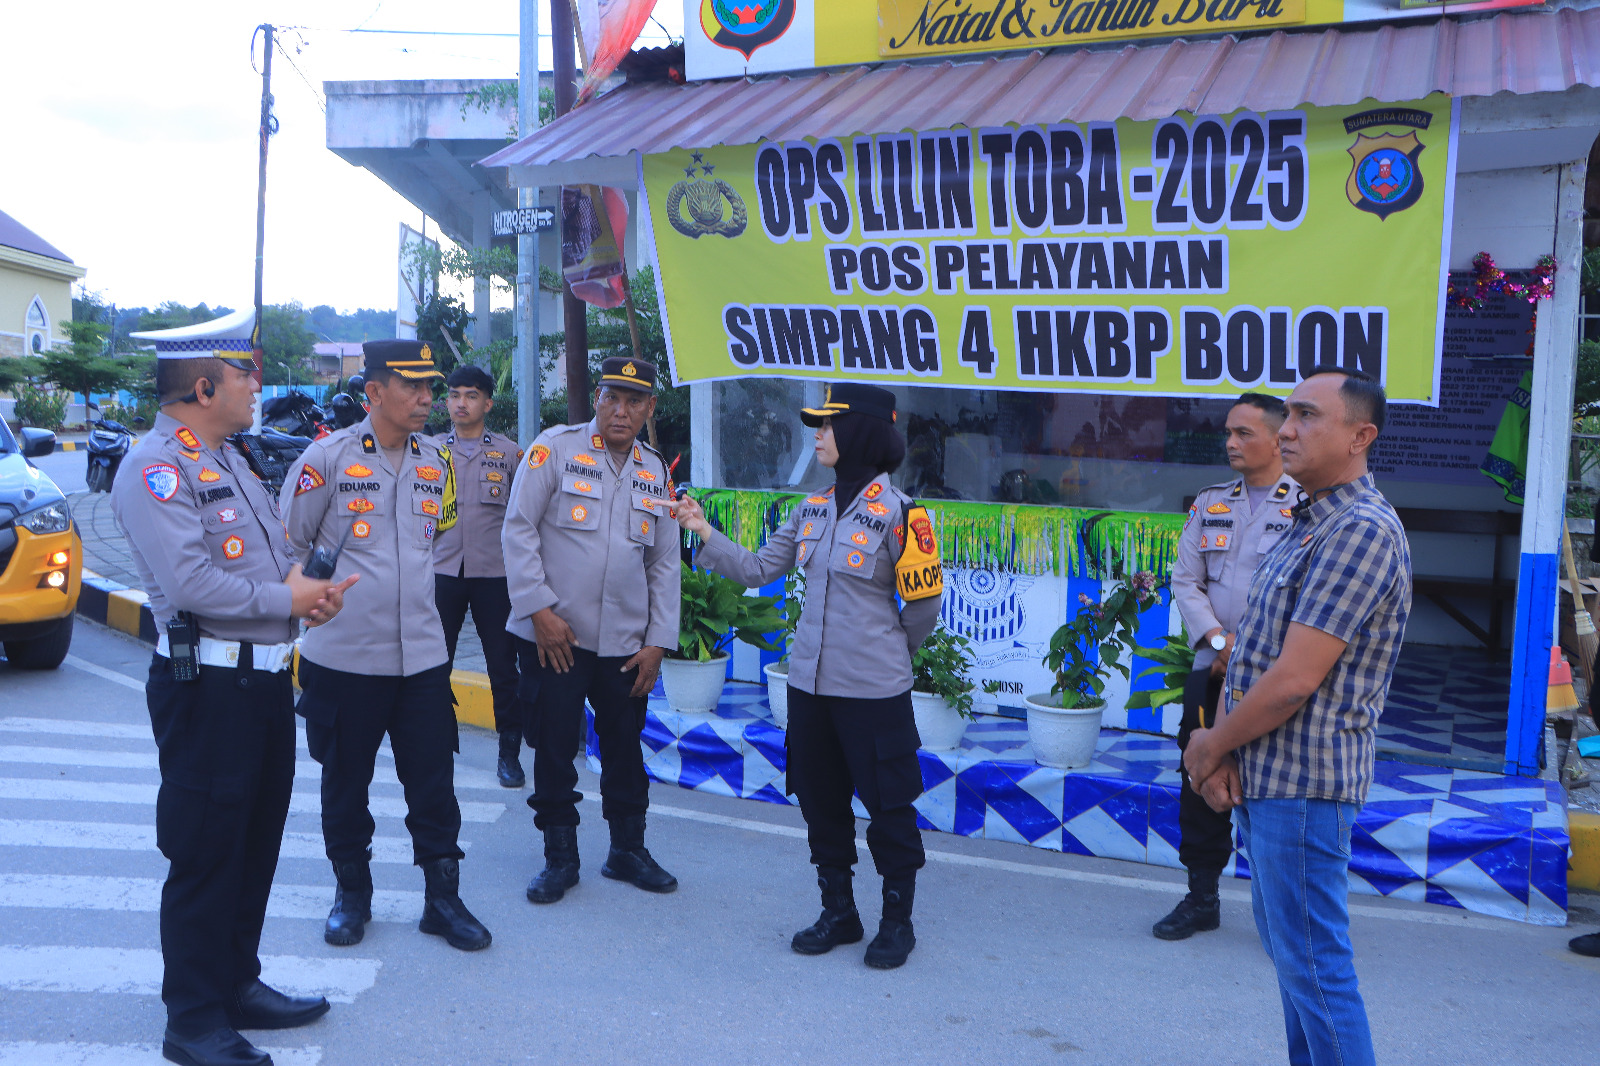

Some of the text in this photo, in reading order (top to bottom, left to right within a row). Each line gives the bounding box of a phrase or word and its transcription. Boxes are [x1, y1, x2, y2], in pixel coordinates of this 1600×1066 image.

[889, 0, 1001, 48] Natal
[1347, 112, 1428, 130] SUMATERA UTARA
[757, 144, 849, 236] OPS
[857, 135, 970, 231] LILIN
[982, 128, 1123, 228] TOBA
[494, 208, 538, 230] NITROGEN
[830, 240, 1223, 291] POS PELAYANAN
[1480, 312, 1521, 320] SAMOSIR
[725, 308, 1383, 383] SIMPANG 4 HKBP BOLON
[481, 461, 508, 470] POLRI
[1405, 460, 1439, 468] POLRES
[1440, 462, 1479, 470] SAMOSIR
[339, 482, 381, 493] EDUARD
[413, 482, 443, 496] POLRI
[632, 480, 663, 497] POLRI
[852, 512, 886, 534] POLRI
[981, 678, 1025, 695] SOSIR
